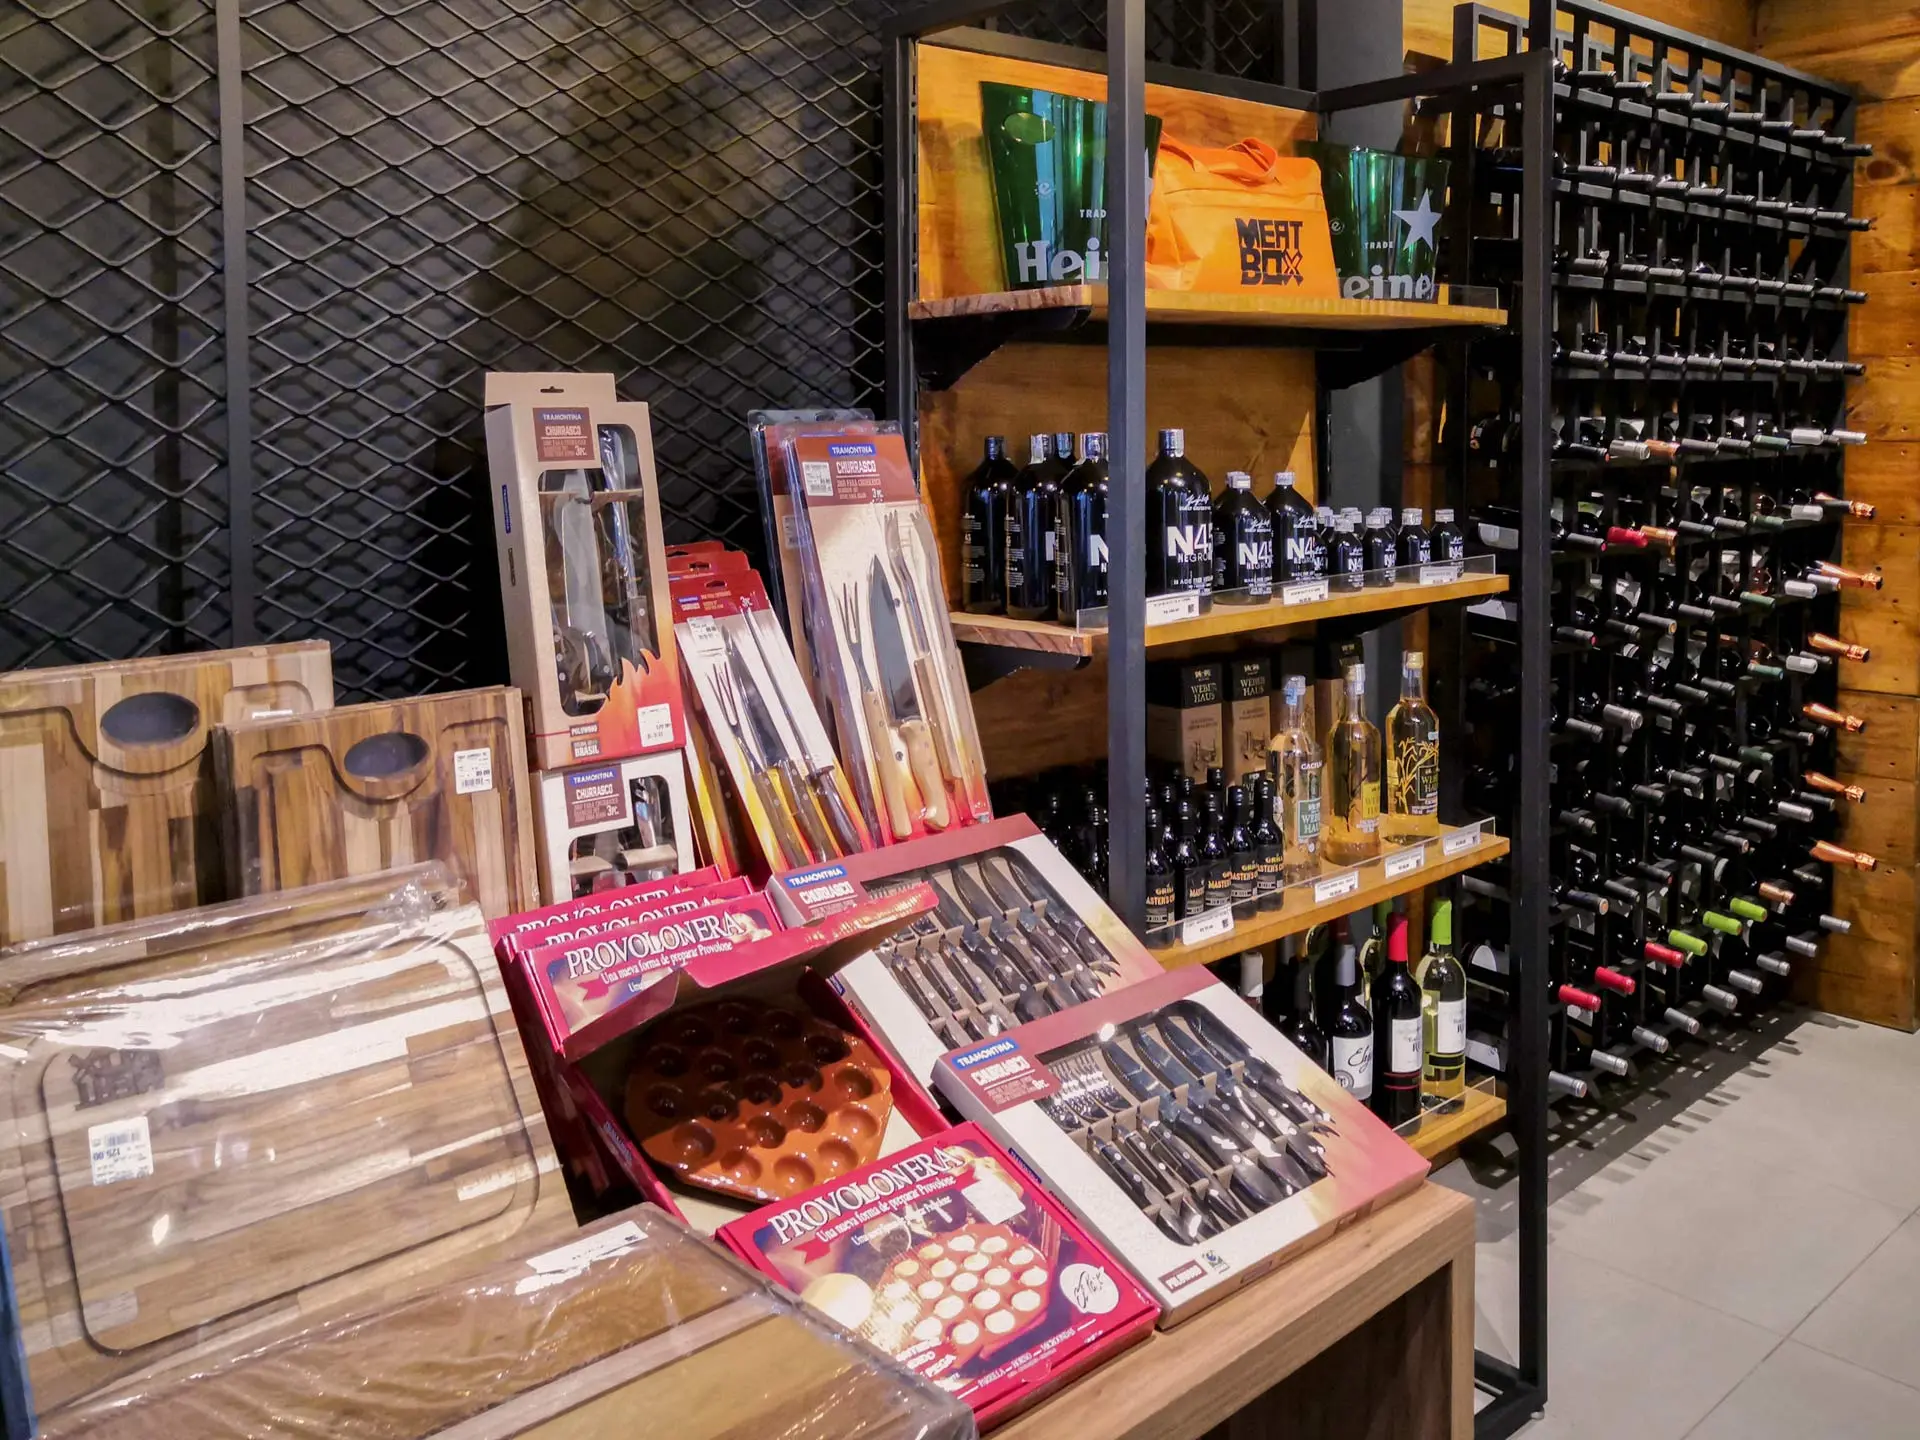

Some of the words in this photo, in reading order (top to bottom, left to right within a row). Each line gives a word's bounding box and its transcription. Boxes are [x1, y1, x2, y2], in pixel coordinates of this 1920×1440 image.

[1235, 218, 1304, 250] MEAT
[1239, 250, 1304, 286] BOX
[831, 446, 873, 455] TRAMONTINA
[836, 460, 877, 474] CHURRASCO
[574, 746, 600, 758] BRASIL
[573, 770, 614, 784] TRAMONTINA
[575, 784, 614, 800] CHURRASCO
[789, 868, 843, 886] TRAMONTINA
[799, 881, 854, 904] CHURRASCO
[565, 911, 749, 979] PROVOLONERA
[601, 969, 619, 985] Una
[618, 966, 640, 980] nueva
[640, 956, 661, 975] forma
[661, 953, 671, 969] de
[671, 946, 699, 967] preparar
[699, 941, 733, 957] Provolone
[957, 1041, 1014, 1067] TRAMONTINA
[768, 1147, 966, 1245] PROVOLONERA
[816, 1226, 834, 1243] Una
[836, 1215, 859, 1232] nueva
[855, 1206, 881, 1223] forma
[878, 1200, 890, 1213] de
[889, 1190, 920, 1211] preparar
[917, 1176, 957, 1198] Provolone
